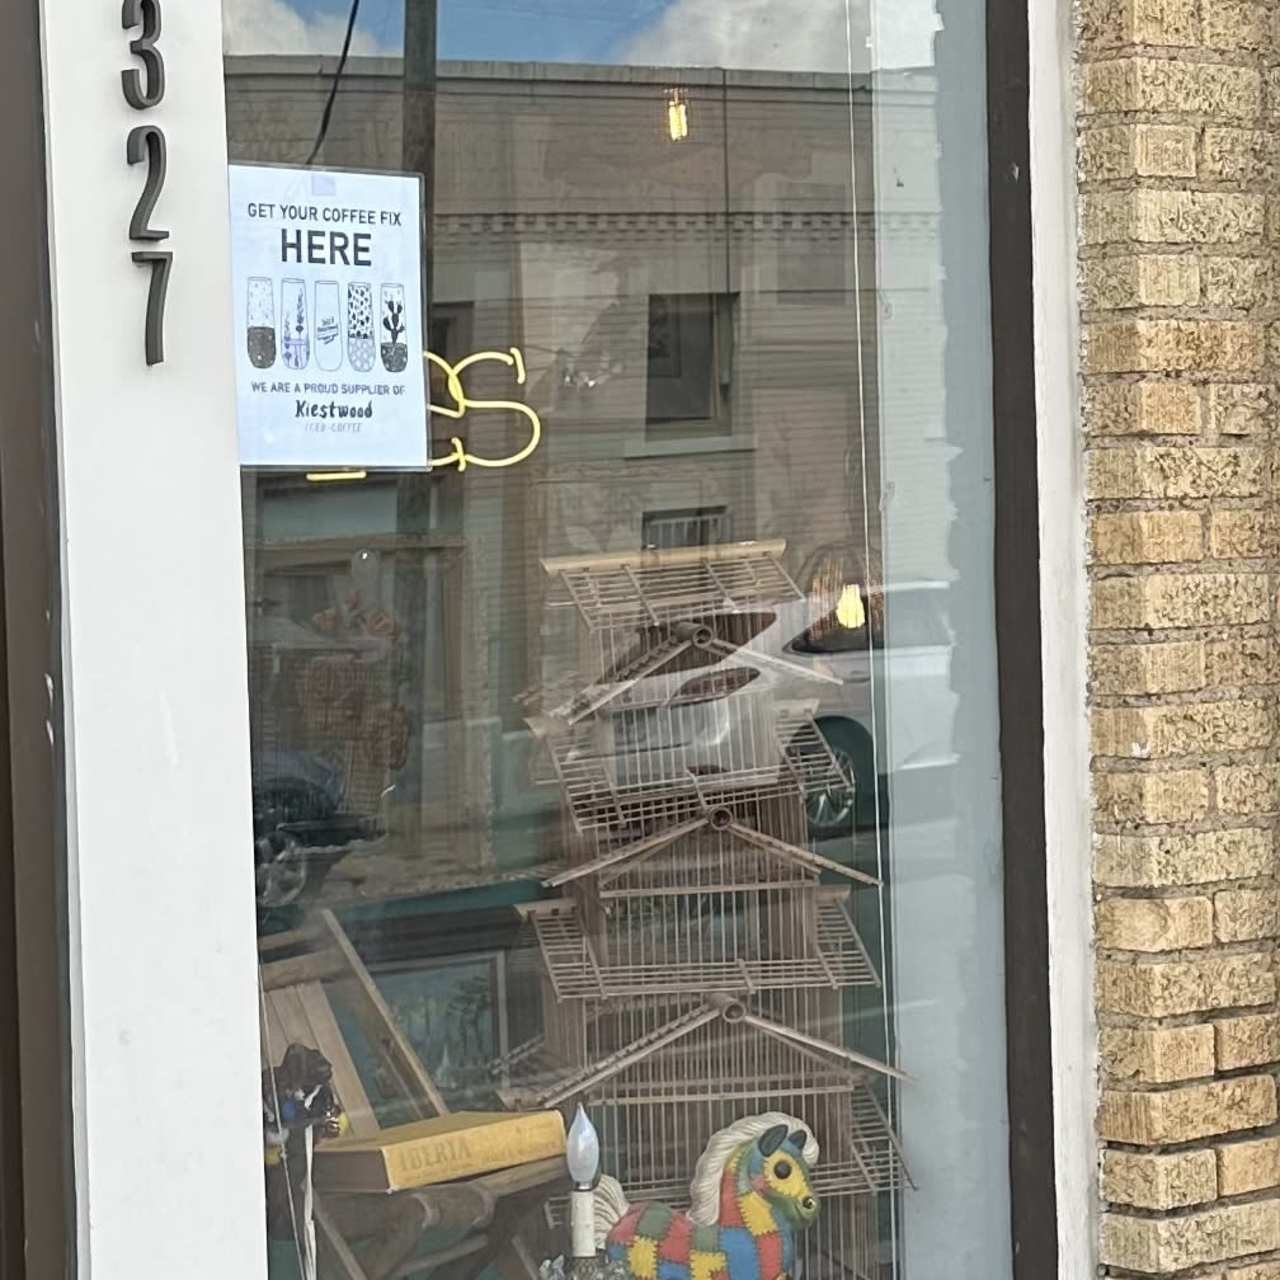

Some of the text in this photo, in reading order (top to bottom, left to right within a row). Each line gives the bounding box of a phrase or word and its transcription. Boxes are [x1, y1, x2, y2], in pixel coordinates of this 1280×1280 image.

[248, 203, 402, 226] GET YOUR COFFEE FIX
[281, 228, 372, 266] HERE
[251, 382, 405, 395] WE ARE A PROUD SUPPLIER OF
[295, 400, 373, 418] Kiestwood
